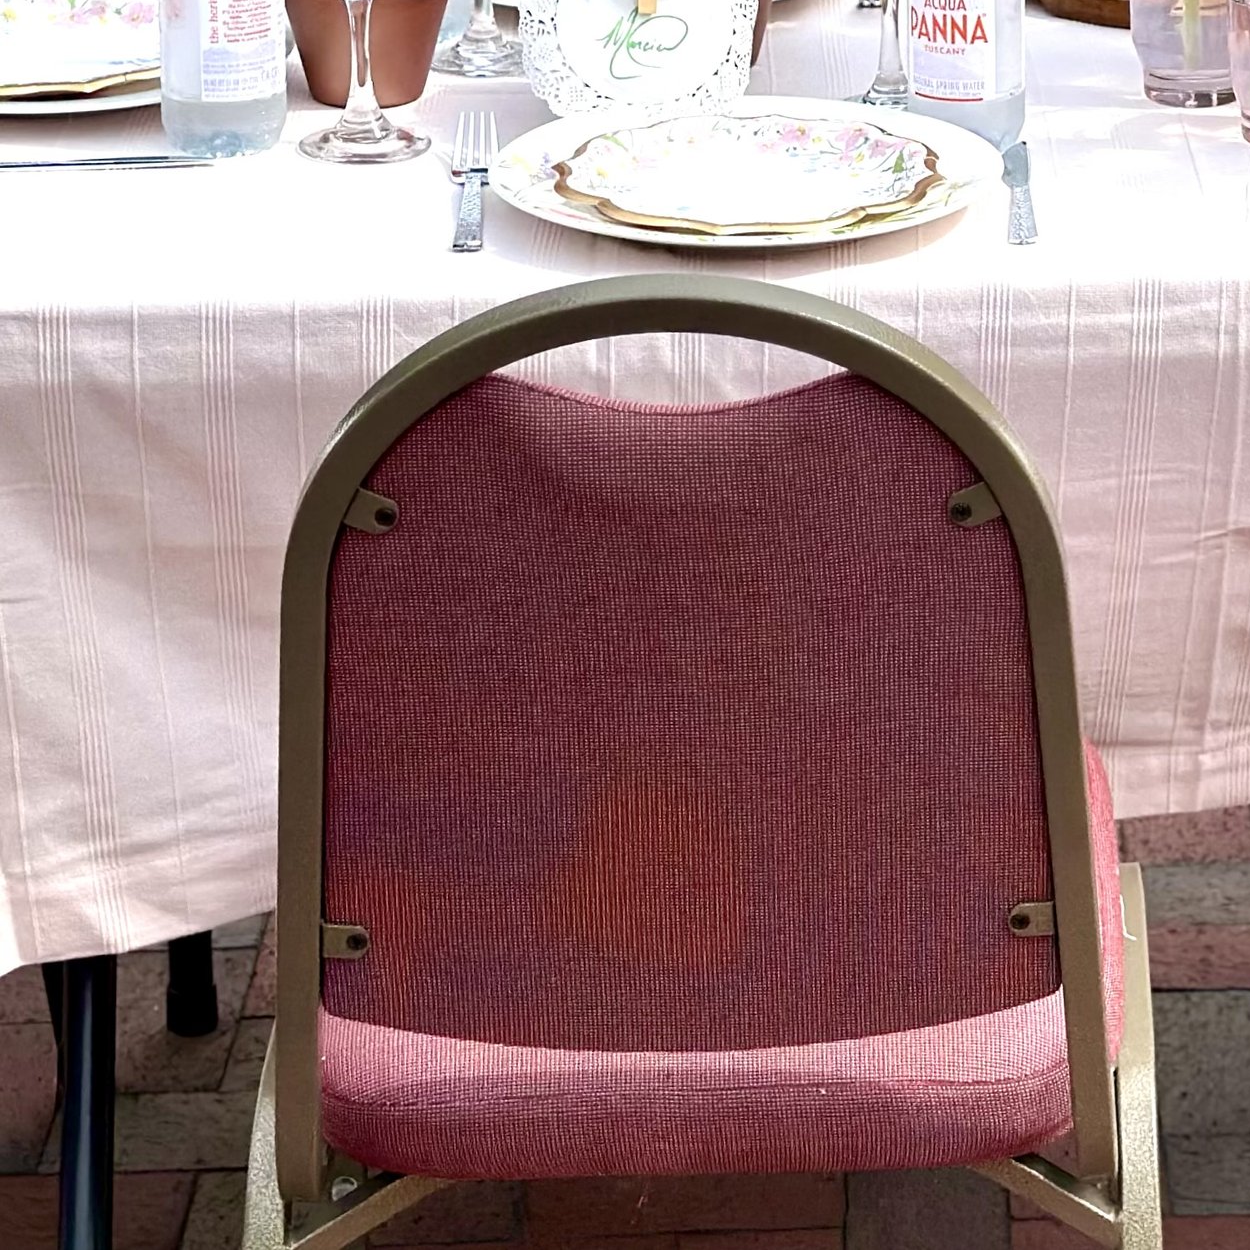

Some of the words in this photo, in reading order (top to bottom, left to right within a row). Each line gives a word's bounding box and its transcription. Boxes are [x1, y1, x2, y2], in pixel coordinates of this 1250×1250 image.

[911, 6, 988, 45] PANNA
[209, 27, 219, 44] the
[924, 44, 966, 56] TUSCANY
[936, 80, 960, 91] SPRING
[962, 81, 985, 91] WATER
